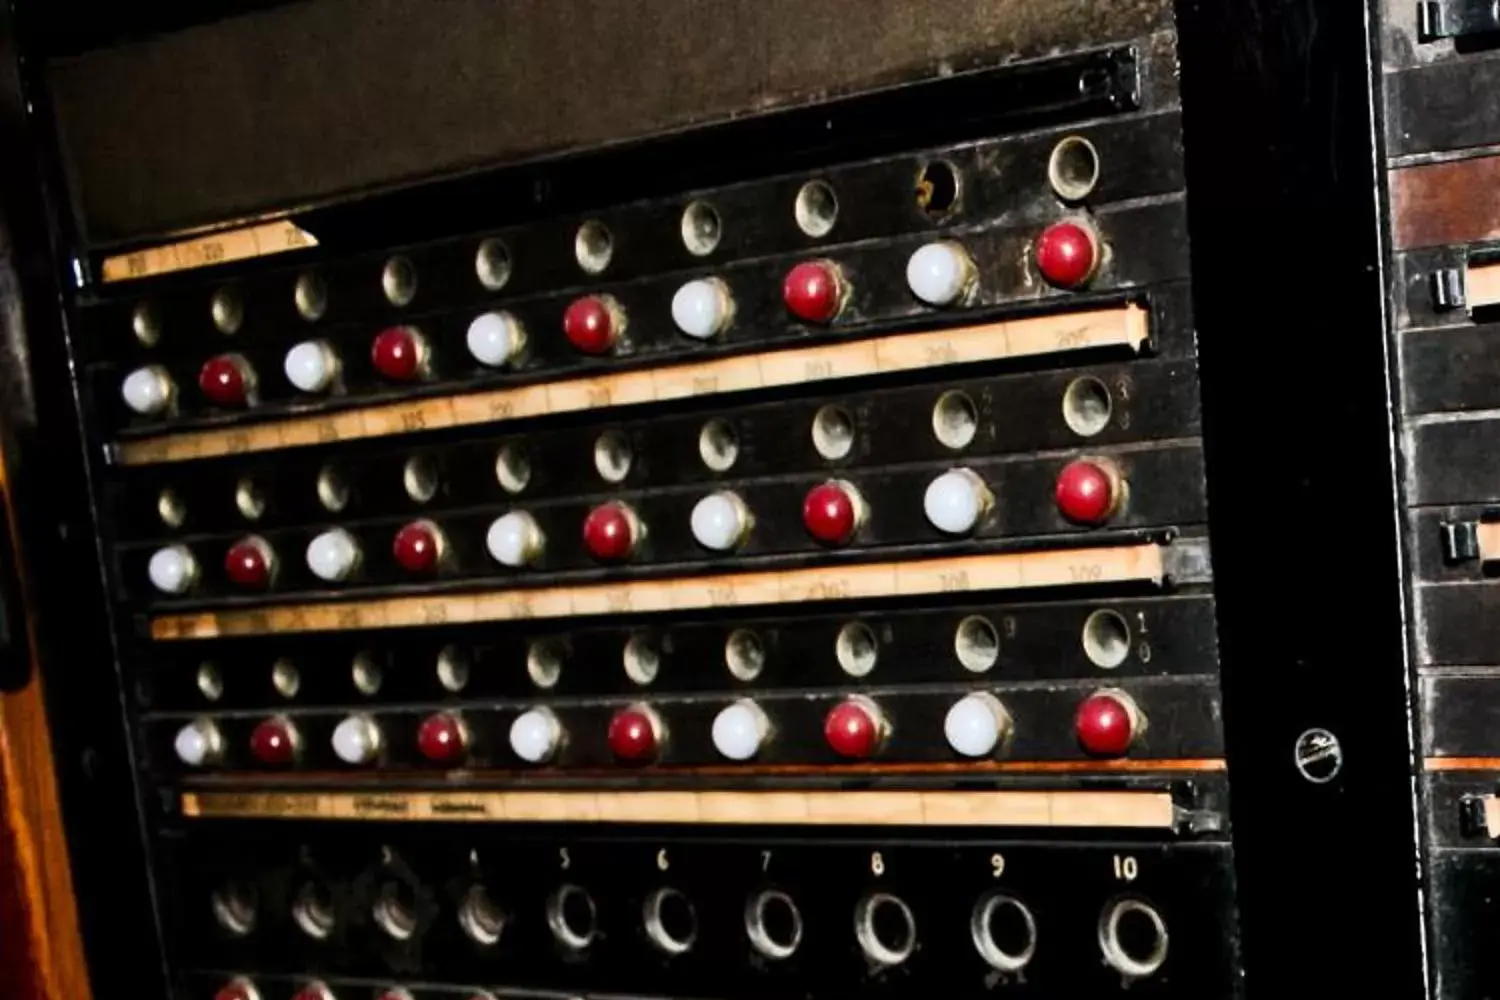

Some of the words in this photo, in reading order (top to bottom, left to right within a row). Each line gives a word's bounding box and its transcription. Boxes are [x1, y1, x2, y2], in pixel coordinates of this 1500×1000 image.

[656, 847, 670, 872] 6
[870, 851, 885, 877] 8
[989, 853, 1004, 880] 9
[1113, 853, 1139, 882] 10
